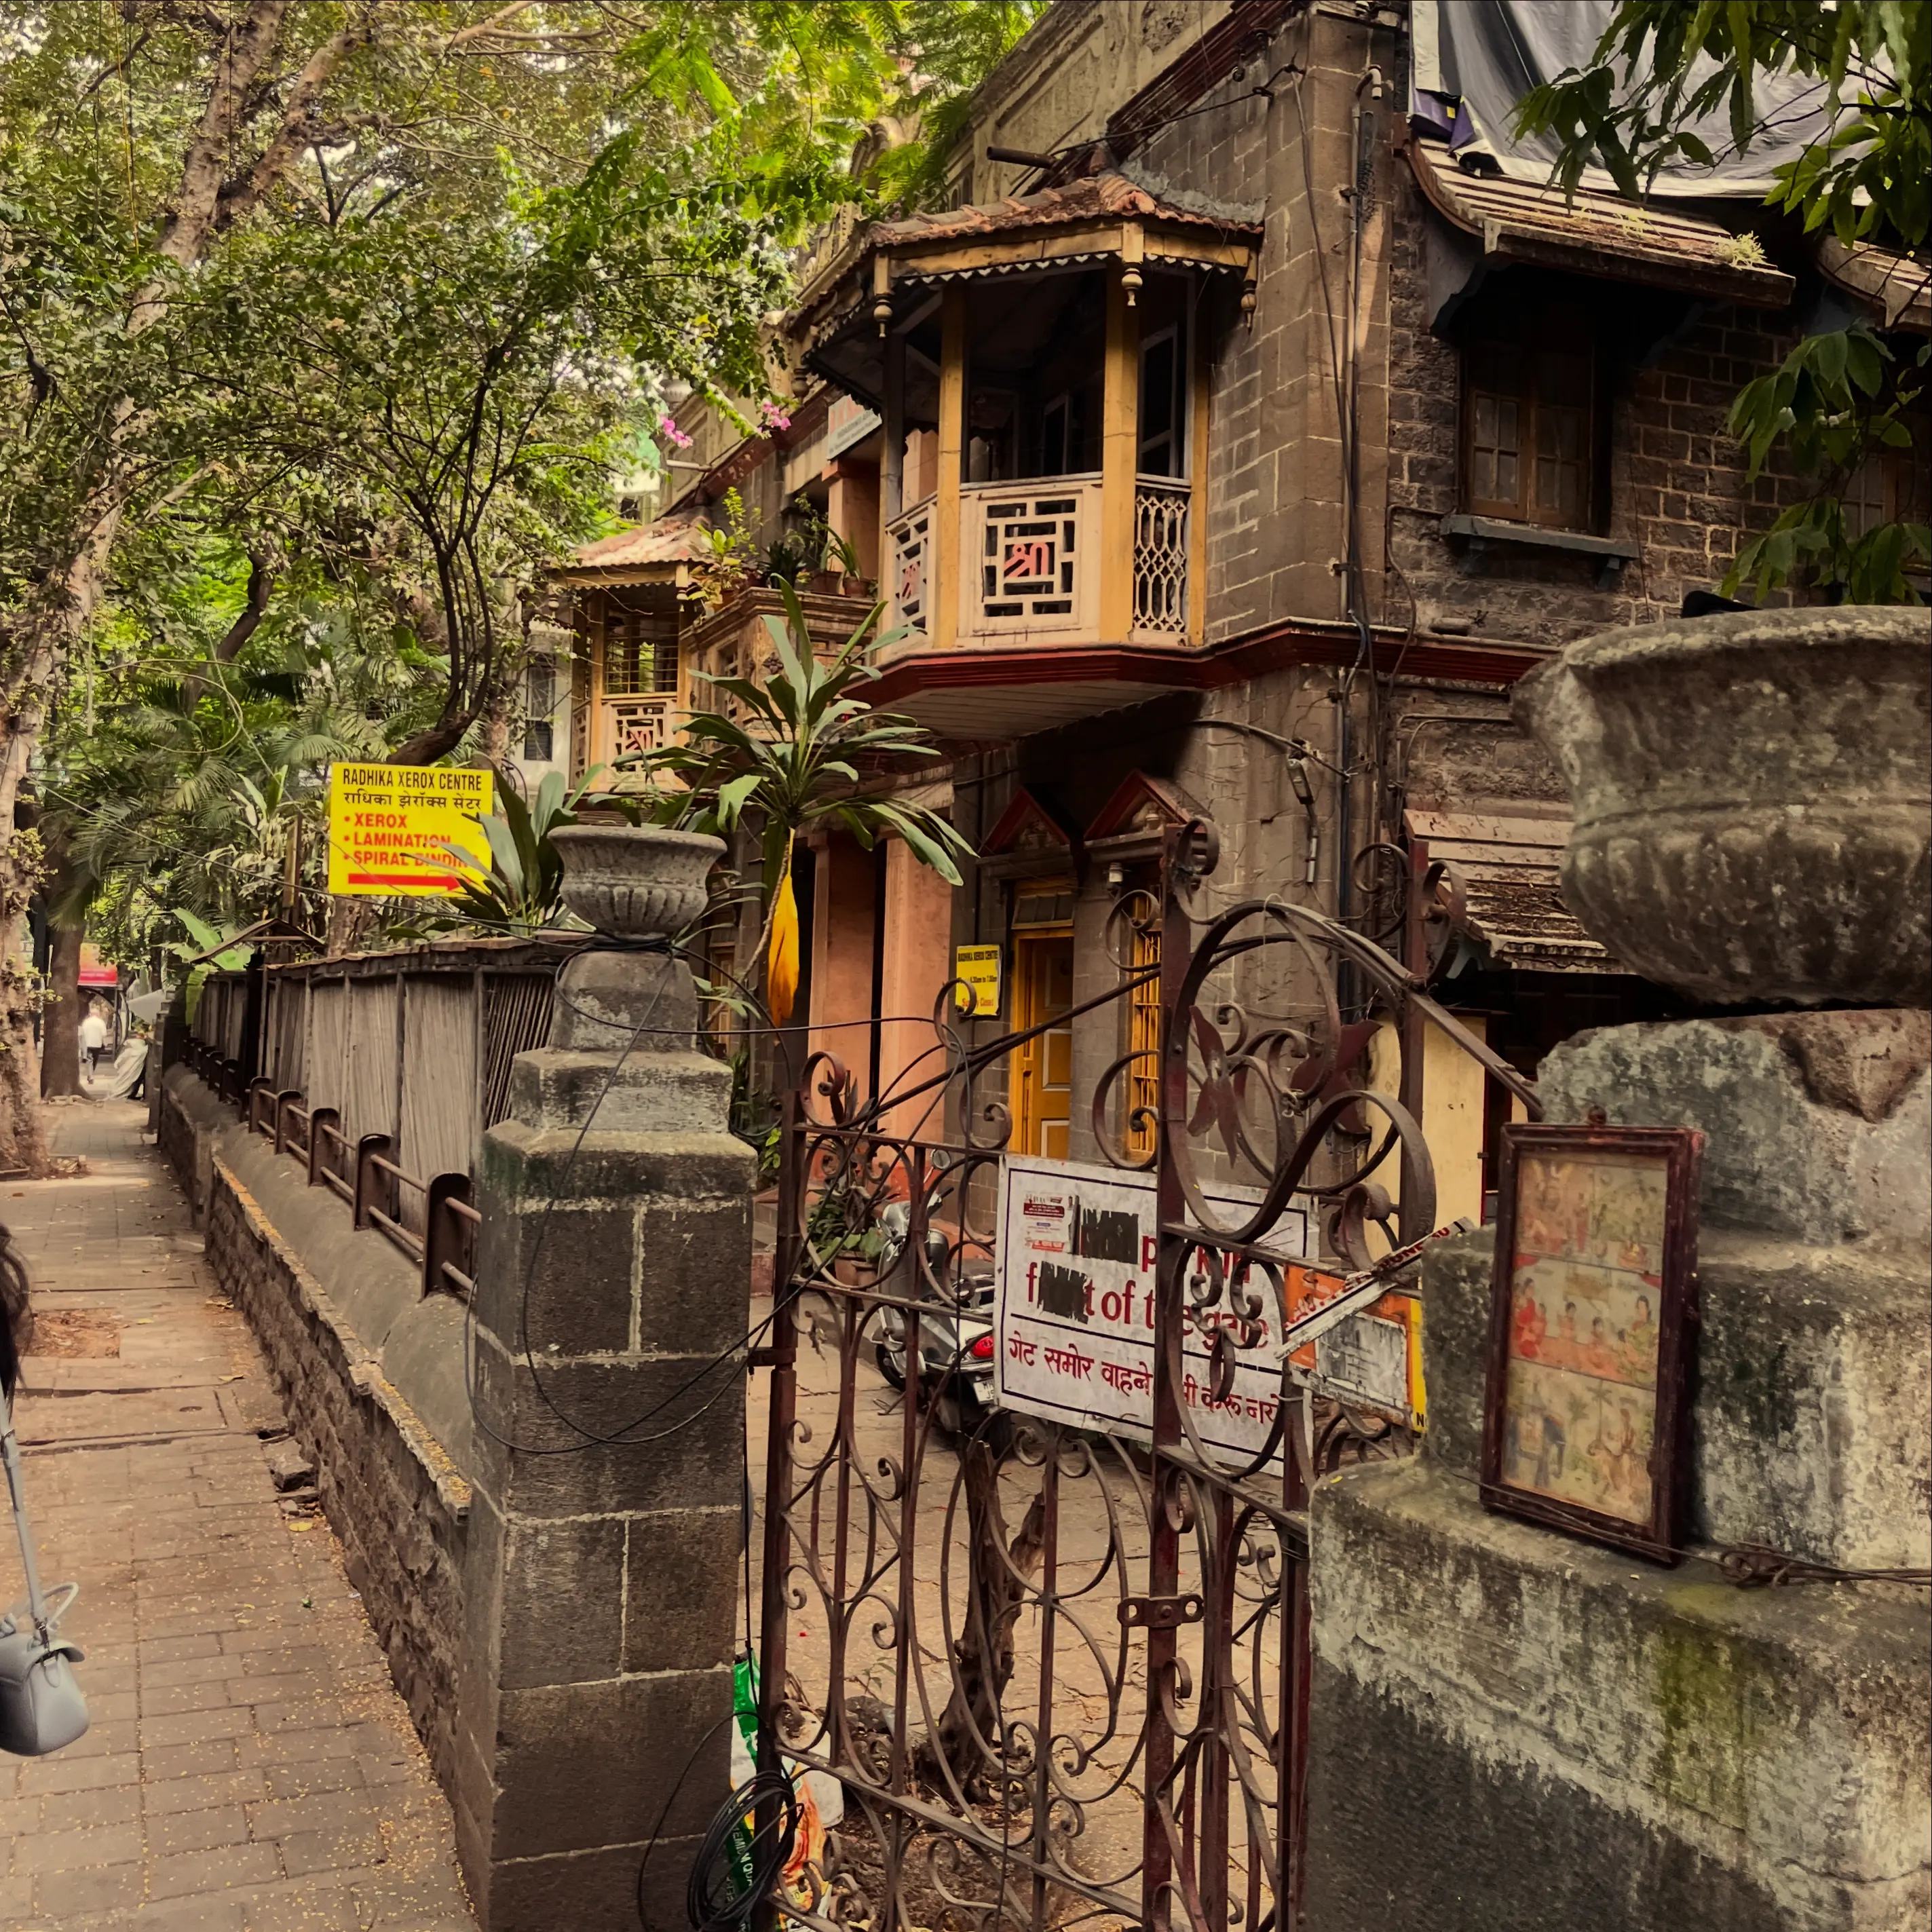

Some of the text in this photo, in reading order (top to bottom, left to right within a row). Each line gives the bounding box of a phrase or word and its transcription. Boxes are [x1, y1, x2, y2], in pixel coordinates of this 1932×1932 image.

[343, 768, 482, 791] RADHIKA XEROX CENTRE
[343, 788, 482, 810] राधिका झेरॉक्स सेंटर
[354, 812, 408, 829] XEROX
[354, 850, 478, 869] SPIRAL BINDI
[1101, 1280, 1136, 1325] of
[1143, 1289, 1194, 1336] te
[1008, 1330, 1038, 1367] गेट
[1044, 1343, 1095, 1382] समोर
[732, 1827, 751, 1863] EMIUM
